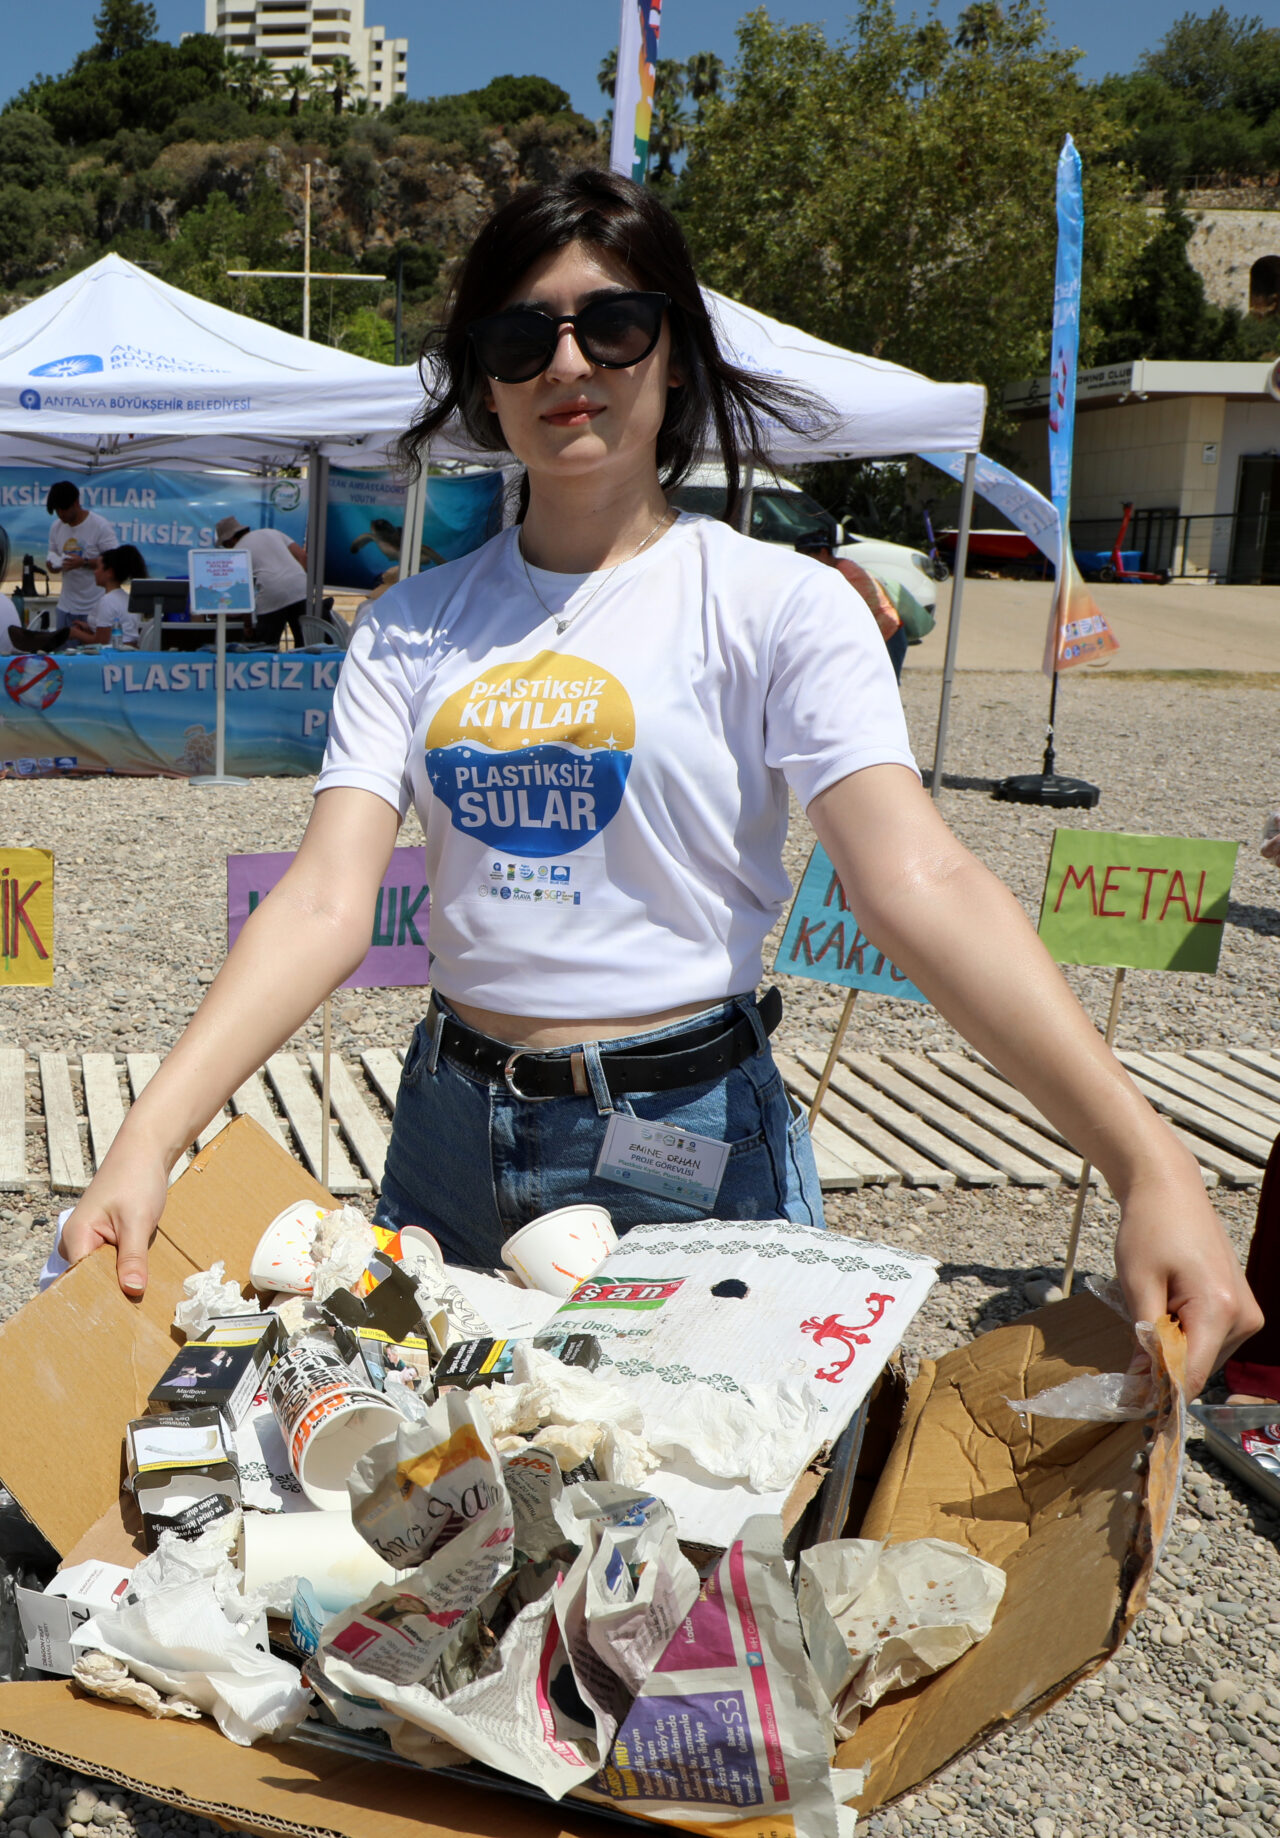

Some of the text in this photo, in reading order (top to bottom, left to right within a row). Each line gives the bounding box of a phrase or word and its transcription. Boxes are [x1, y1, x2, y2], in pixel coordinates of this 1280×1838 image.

[44, 395, 251, 412] ANTALYA BÜYÜKŞEHİR BELEDİYESİ
[79, 487, 158, 509] IYILAR
[350, 481, 406, 494] AMBASSADORS
[111, 518, 194, 547] TİKSİZ
[102, 654, 305, 694] PLASTKSİZ
[468, 674, 608, 700] PLASTİKSİZ
[458, 697, 599, 729] KIYILAR
[455, 757, 595, 790] PLASTİKSİZ
[459, 787, 598, 831] SULAR
[1053, 863, 1223, 925] METAL
[628, 1143, 701, 1170] EMİNE ORHAN
[631, 1154, 695, 1177] PROJE GÖREVLİSİ
[582, 1320, 653, 1336] ÜRÜNLERİ
[184, 1496, 219, 1518] neden olur.
[196, 1509, 215, 1525] cinsel
[215, 1505, 224, 1514] ve
[685, 1616, 696, 1644] kadar
[714, 1698, 743, 1724] S3
[633, 1728, 645, 1753] oyun
[679, 1713, 695, 1755] zamanla
[696, 1721, 709, 1754] ilişkiye
[726, 1727, 737, 1747] Bahar
[701, 1756, 711, 1768] her
[713, 1748, 724, 1765] olan
[716, 1768, 728, 1787] sözü
[730, 1770, 744, 1803] nahif bir
